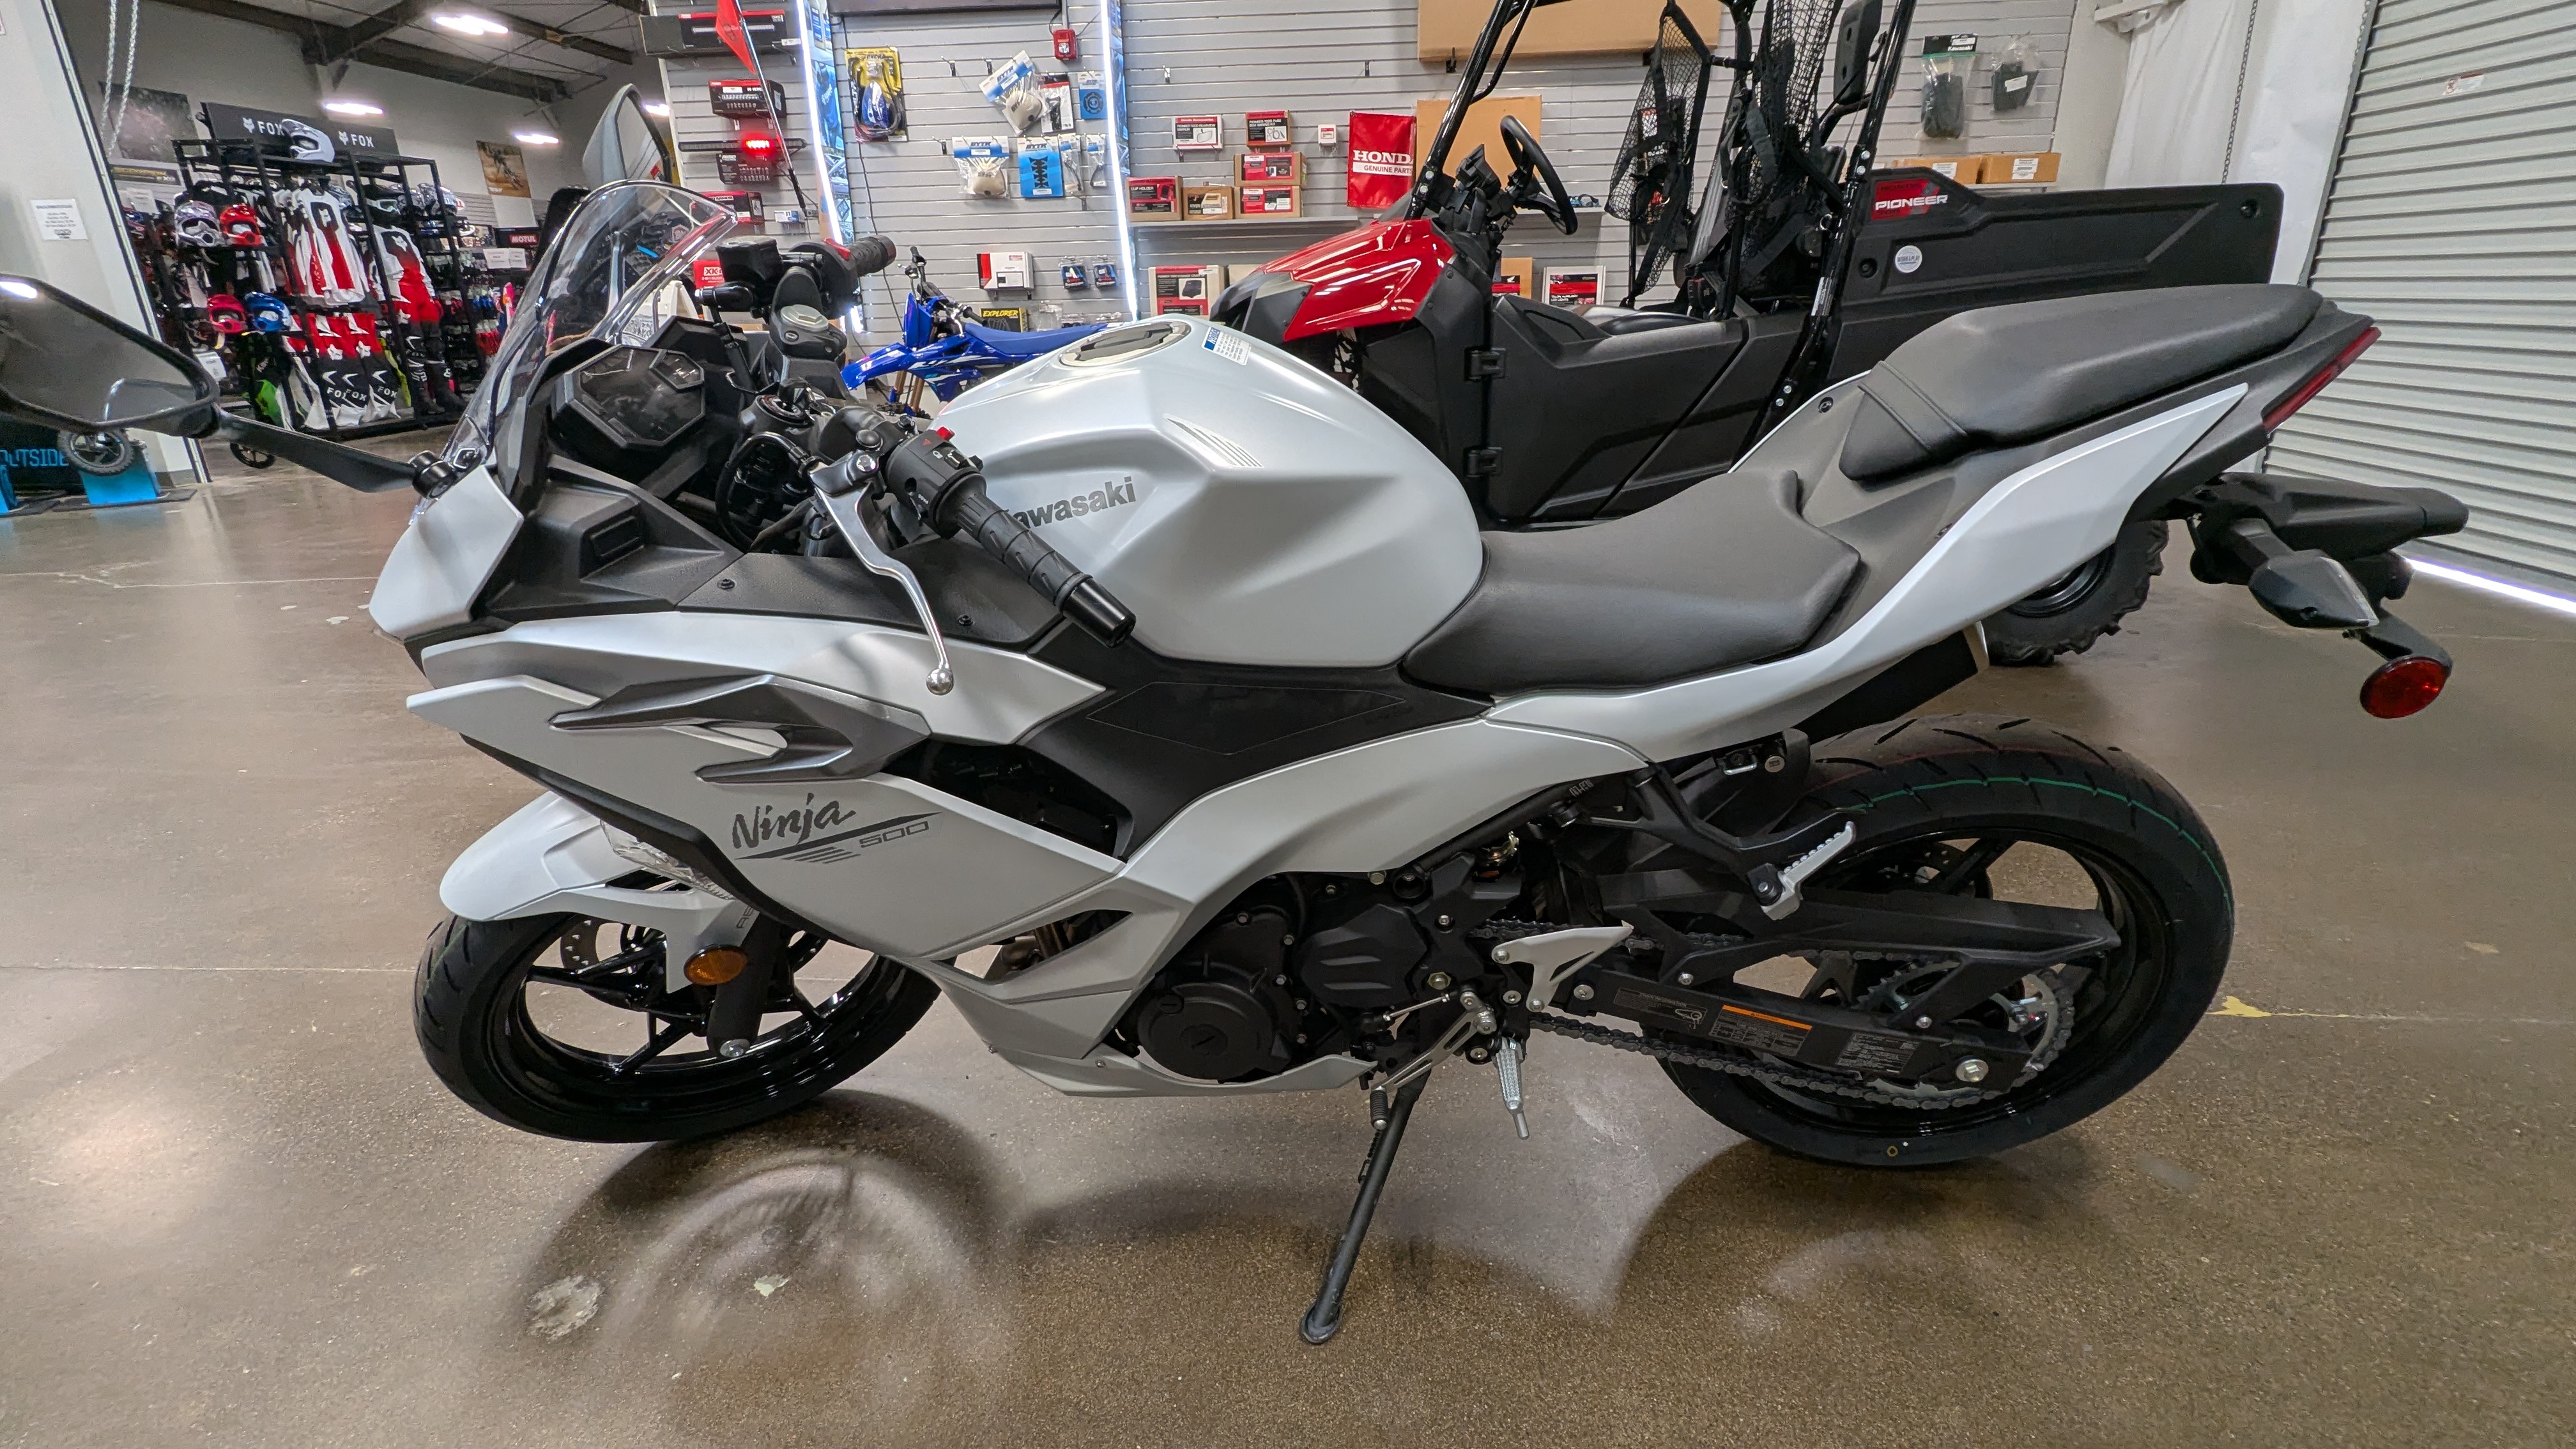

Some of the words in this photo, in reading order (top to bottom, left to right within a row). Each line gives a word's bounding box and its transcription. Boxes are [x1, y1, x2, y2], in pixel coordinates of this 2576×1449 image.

[257, 121, 284, 136] FOX
[351, 134, 374, 148] FOX
[1353, 150, 1414, 164] HOND
[1364, 165, 1392, 173] GENUINE
[1875, 194, 1949, 211] PIONEER
[512, 234, 538, 244] MOTUL
[346, 388, 368, 401] FOX
[377, 386, 398, 399] FOX
[0, 448, 69, 467] OUTSIDE
[1014, 475, 1137, 529] awasaki
[732, 792, 856, 848] Ninja
[859, 820, 930, 848] 500
